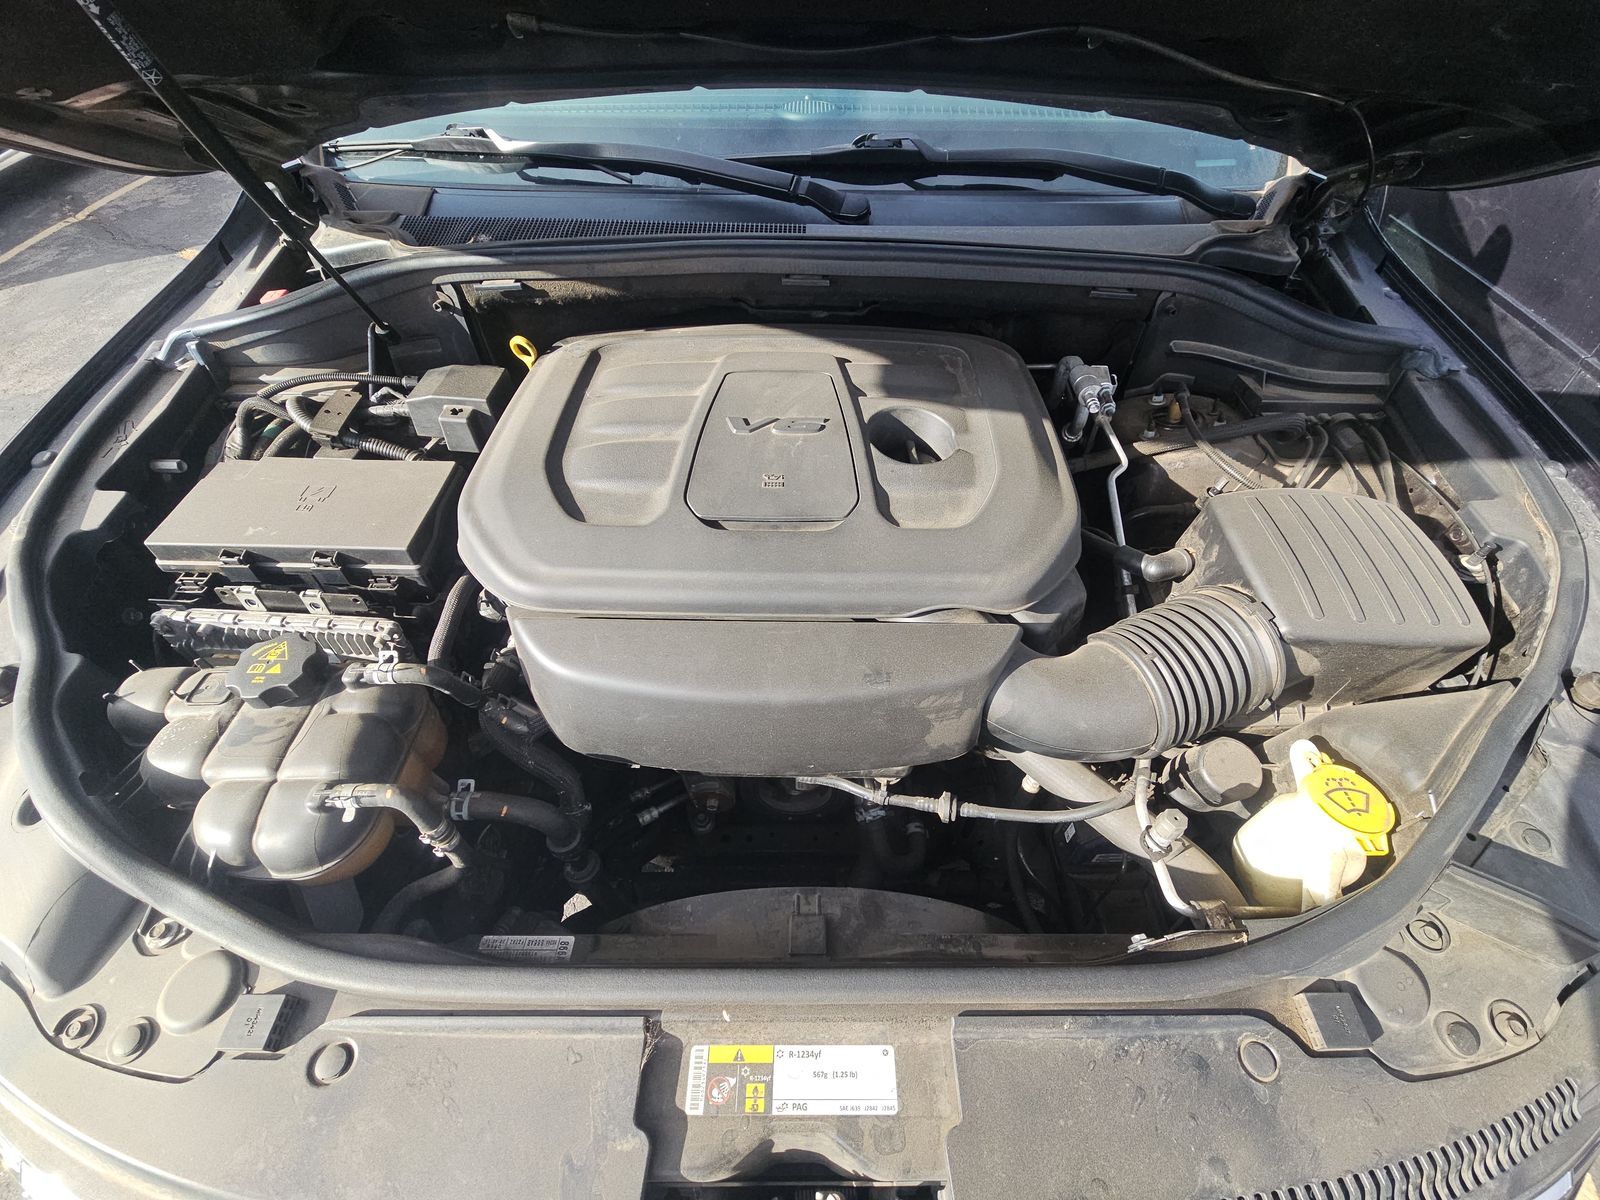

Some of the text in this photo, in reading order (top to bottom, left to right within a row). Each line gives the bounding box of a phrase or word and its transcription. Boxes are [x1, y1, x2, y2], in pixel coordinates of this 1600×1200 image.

[726, 416, 830, 435] V6
[788, 1050, 822, 1060] R-1234yf
[812, 1071, 828, 1080] 567g
[849, 1071, 858, 1080] lb)
[792, 1103, 808, 1111] PAG
